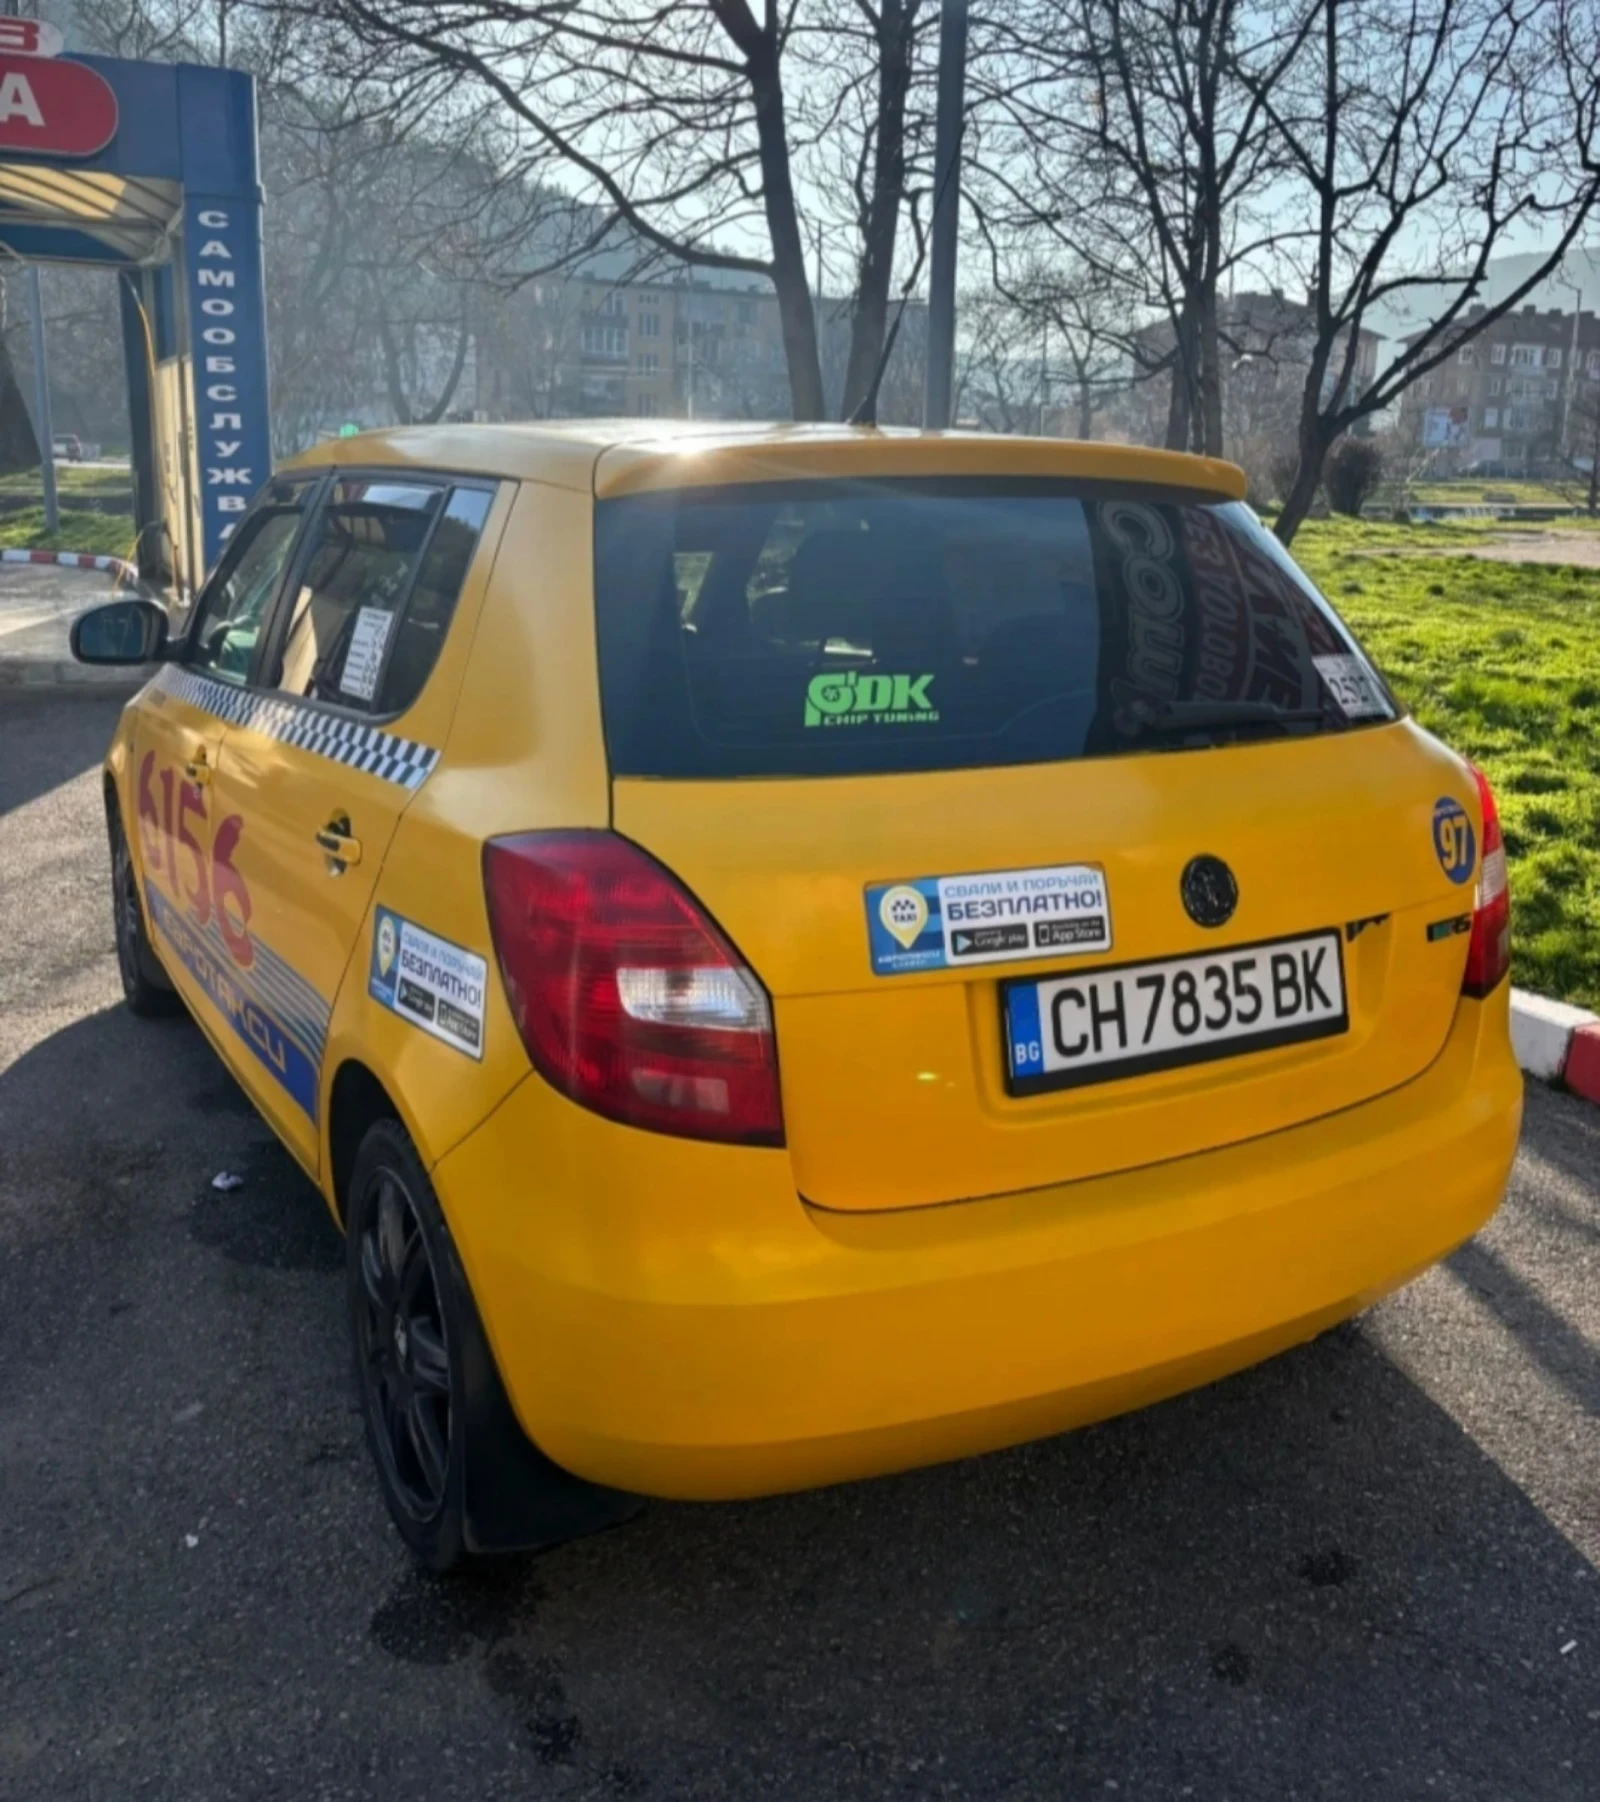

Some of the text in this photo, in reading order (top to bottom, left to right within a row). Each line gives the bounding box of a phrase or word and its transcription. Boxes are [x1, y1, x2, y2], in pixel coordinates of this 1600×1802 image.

[823, 713, 869, 726] CHIP
[1439, 815, 1467, 869] 97
[139, 750, 255, 968] 6156
[945, 881, 1002, 897] СВАЛИ
[1006, 880, 1018, 892] И
[947, 890, 1102, 921] БЕЗПЛАТНО!
[893, 913, 917, 923] TAXI
[1052, 927, 1101, 942] App Store
[401, 949, 482, 1009] БЕЗПЛАТНО!
[1015, 1042, 1040, 1065] BG
